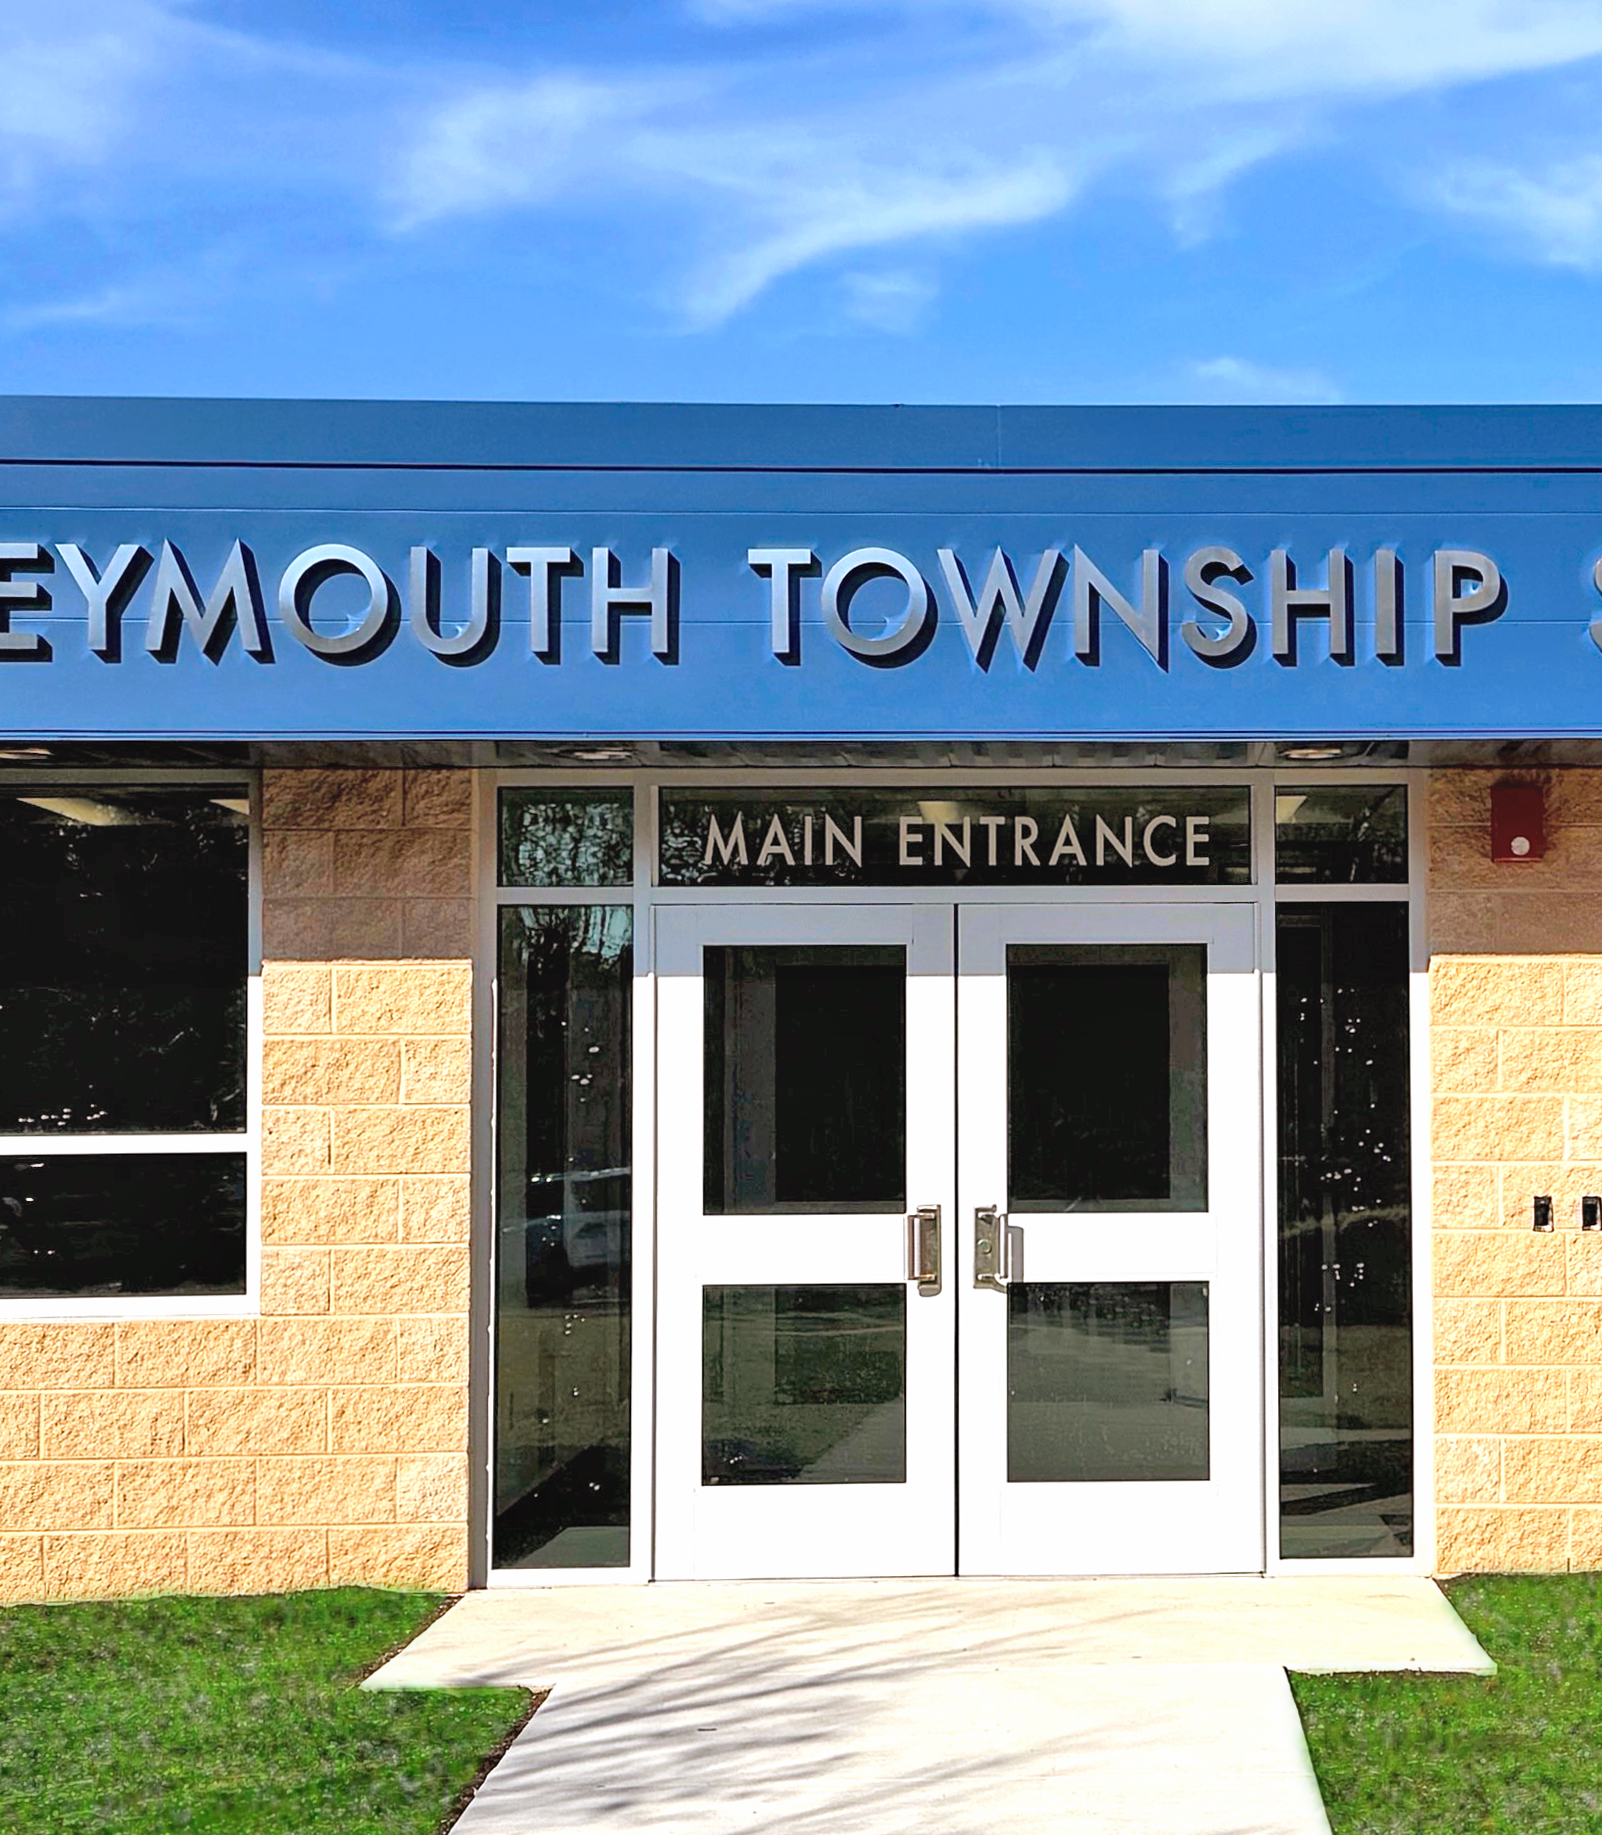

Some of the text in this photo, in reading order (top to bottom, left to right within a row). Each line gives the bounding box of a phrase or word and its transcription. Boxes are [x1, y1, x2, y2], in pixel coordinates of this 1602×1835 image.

[746, 543, 1505, 666] TOWNSHIP
[701, 812, 1212, 869] MAIN ENTRANCE
